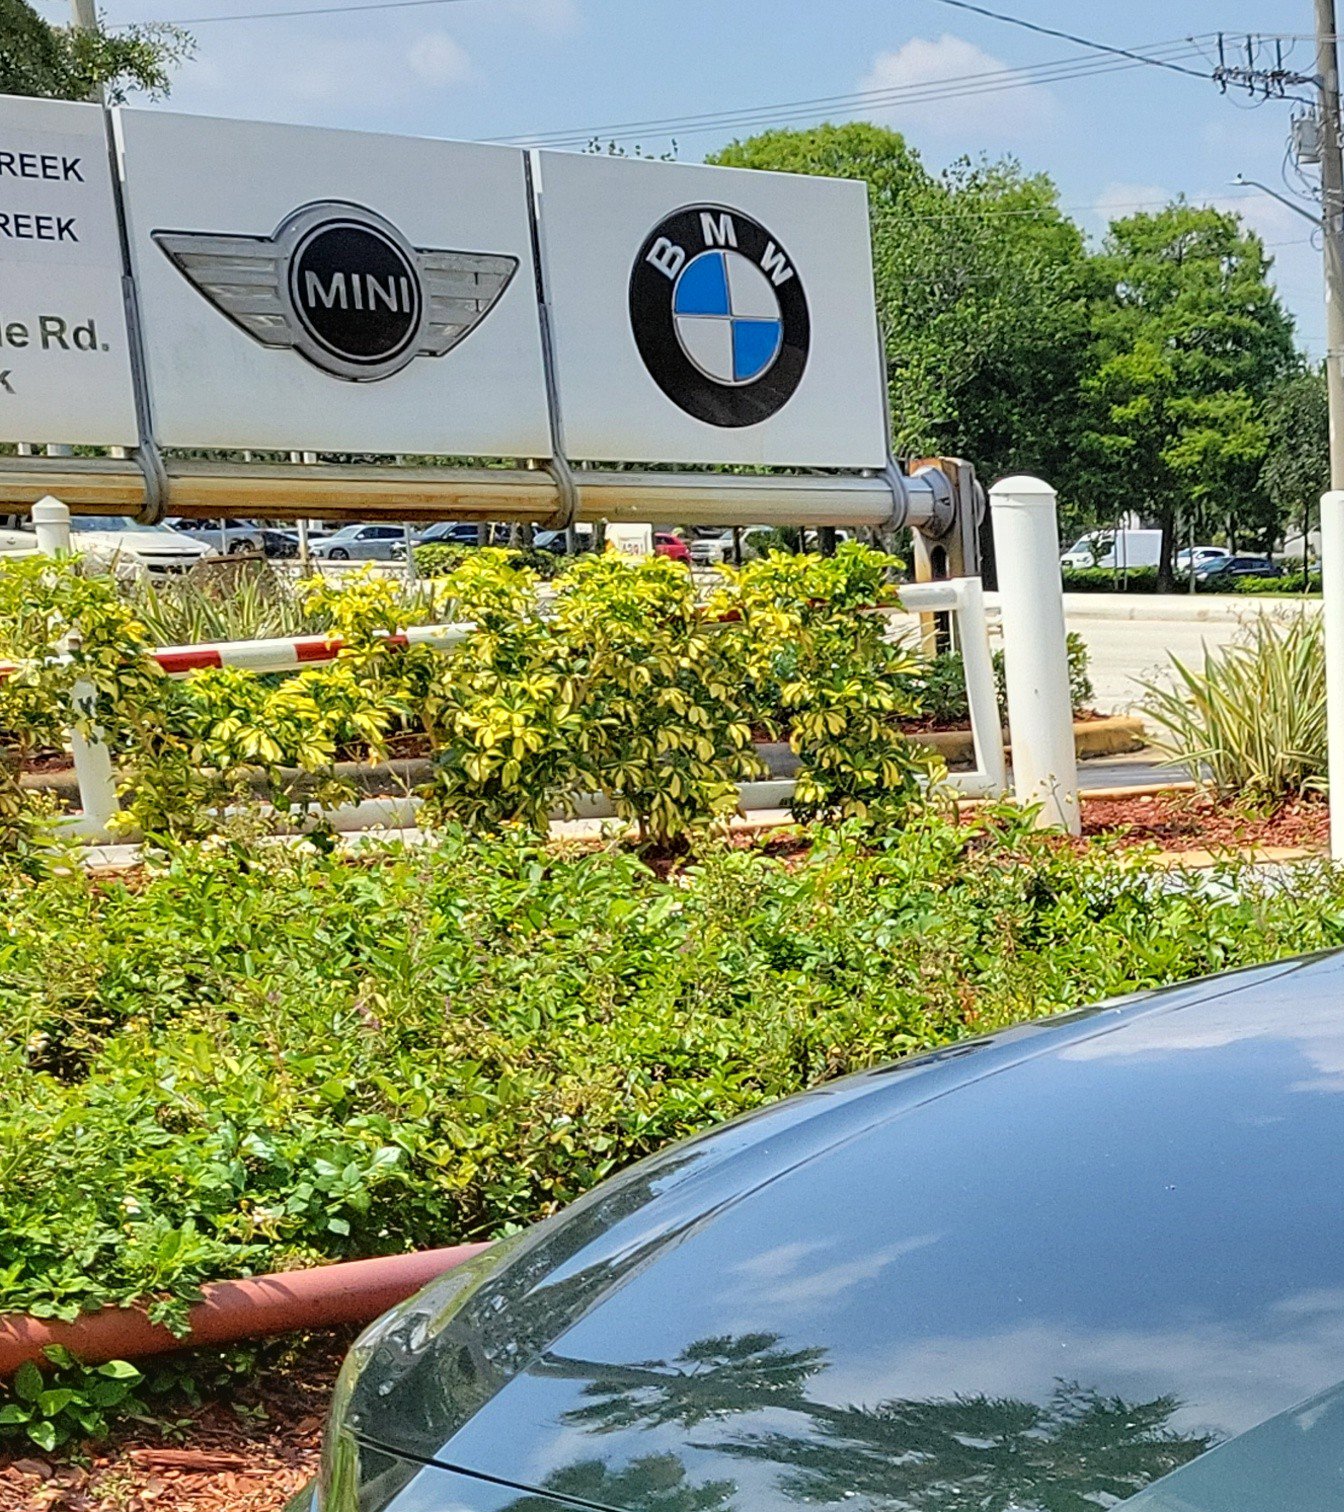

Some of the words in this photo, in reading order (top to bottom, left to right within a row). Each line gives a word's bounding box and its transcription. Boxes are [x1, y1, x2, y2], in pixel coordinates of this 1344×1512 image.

[0, 152, 85, 182] REEK
[646, 211, 794, 287] BMW
[304, 269, 411, 314] MINI
[39, 315, 110, 352] Rd.
